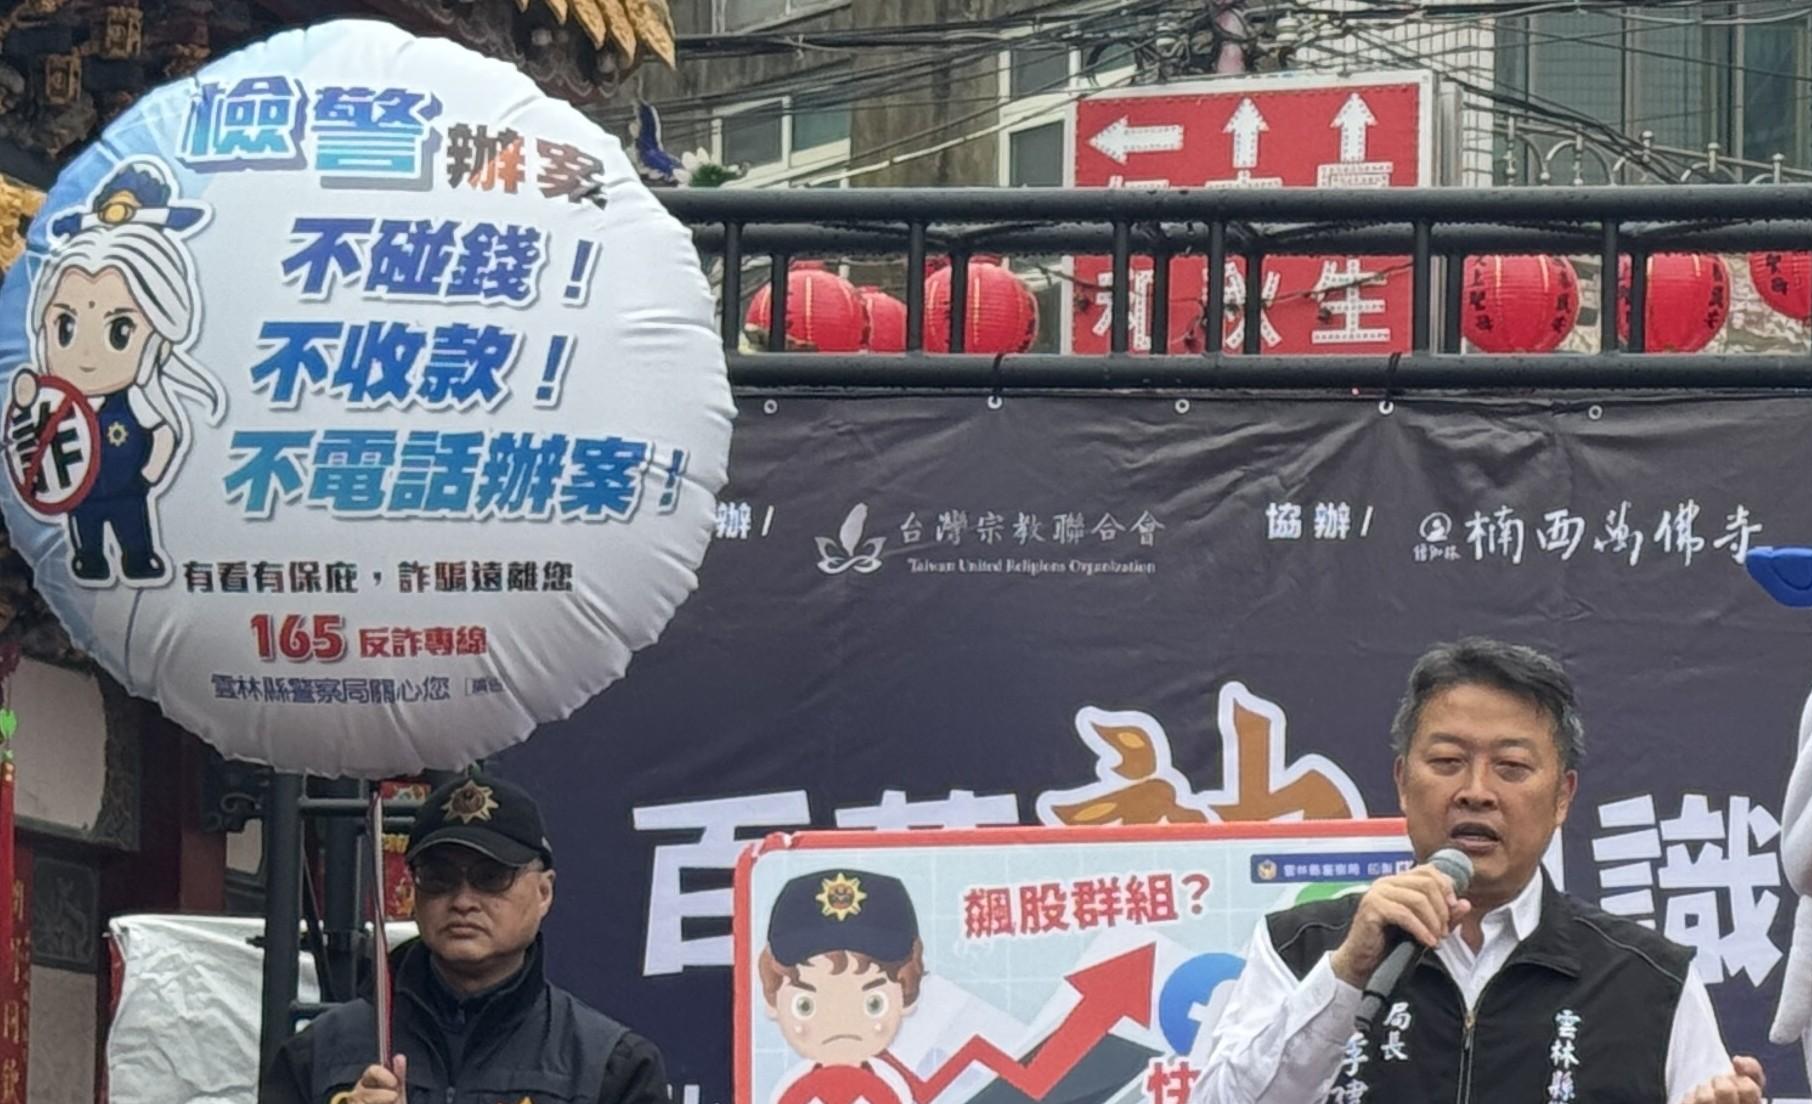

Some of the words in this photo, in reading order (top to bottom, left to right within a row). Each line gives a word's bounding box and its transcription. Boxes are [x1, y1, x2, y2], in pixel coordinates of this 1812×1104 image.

[282, 217, 599, 303] 不碰錢！
[252, 321, 572, 405] 不收款！
[223, 430, 688, 517] 不電話辦案！
[714, 501, 775, 540] 辦/
[899, 508, 1166, 548] 台灣宗教聯合會
[183, 560, 574, 594] 有看有保庇，詐騙遠離您
[907, 557, 956, 573] Taiwan
[958, 557, 1003, 573] United
[1068, 557, 1157, 577] Organization
[249, 613, 348, 662] 165
[358, 626, 488, 658] 反詐專線
[1380, 1001, 1412, 1061] 局長
